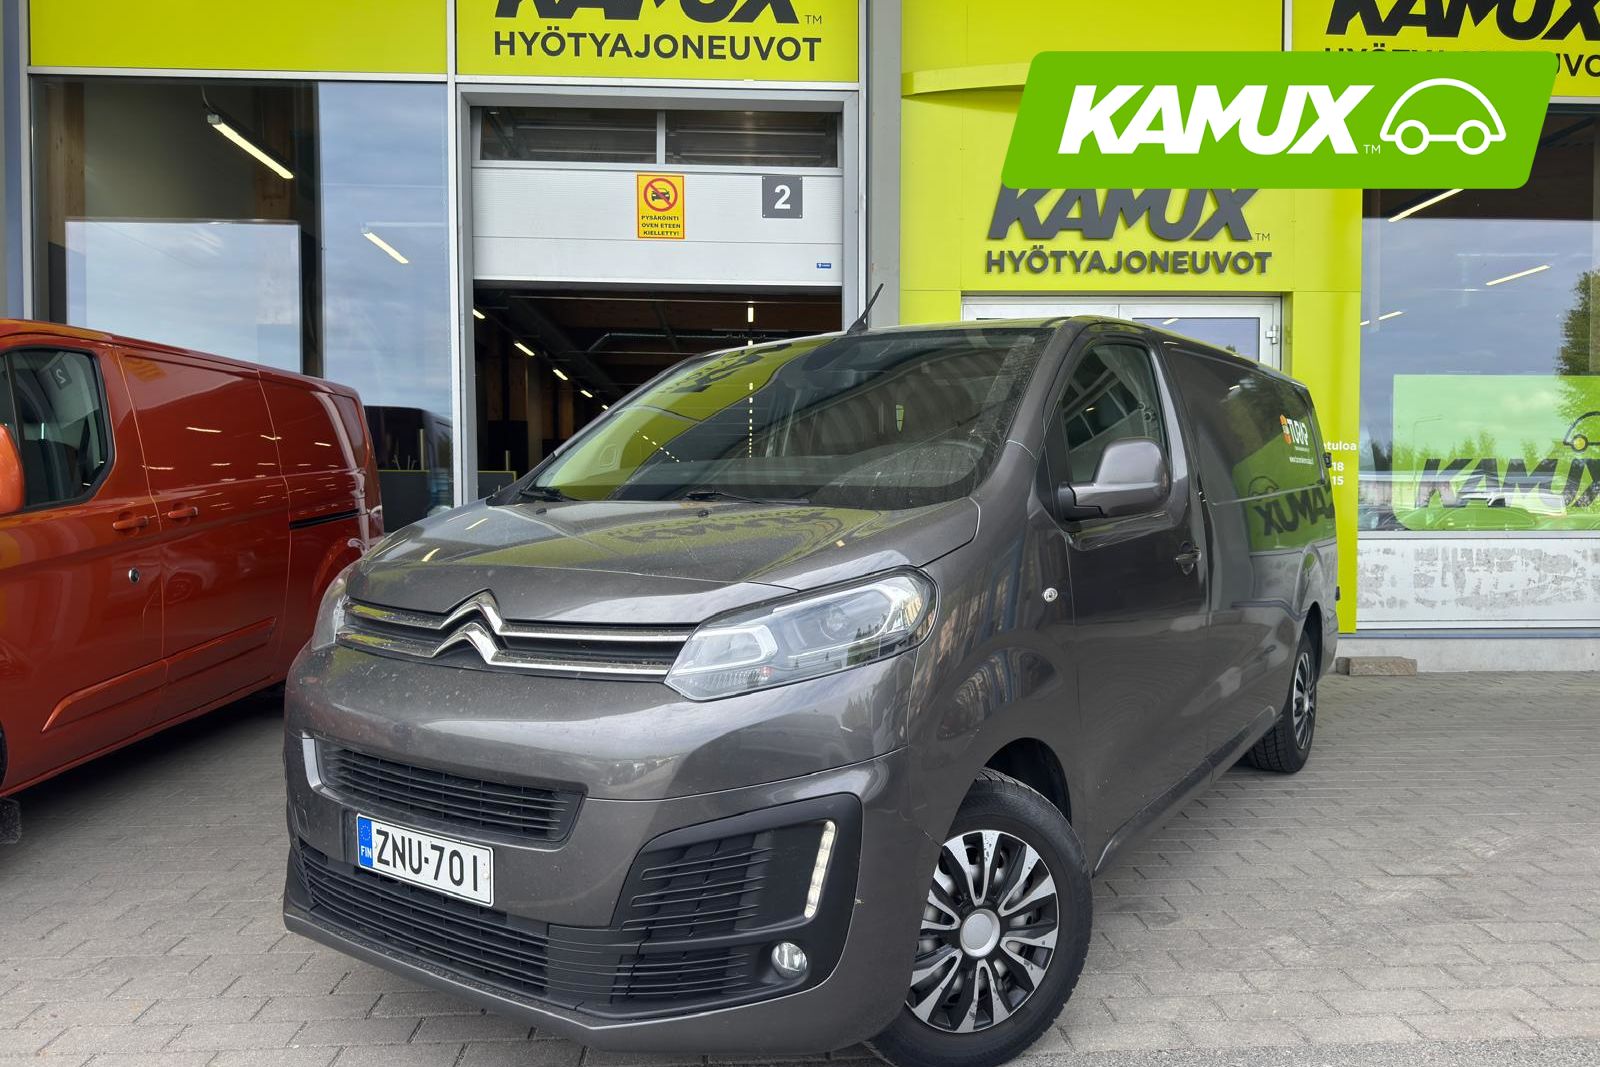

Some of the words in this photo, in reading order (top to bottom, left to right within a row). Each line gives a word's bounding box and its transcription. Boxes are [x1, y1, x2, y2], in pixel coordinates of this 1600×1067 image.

[494, 25, 822, 62] HYÖTYAJONEUVOT
[774, 184, 791, 210] 2
[987, 183, 1260, 241] KAMUX
[986, 244, 1272, 274] HYÖTYAJONEUVOT
[1333, 461, 1345, 471] 18
[1333, 475, 1345, 486] 15
[360, 845, 372, 859] FIN
[376, 828, 478, 893] ZNU-701
